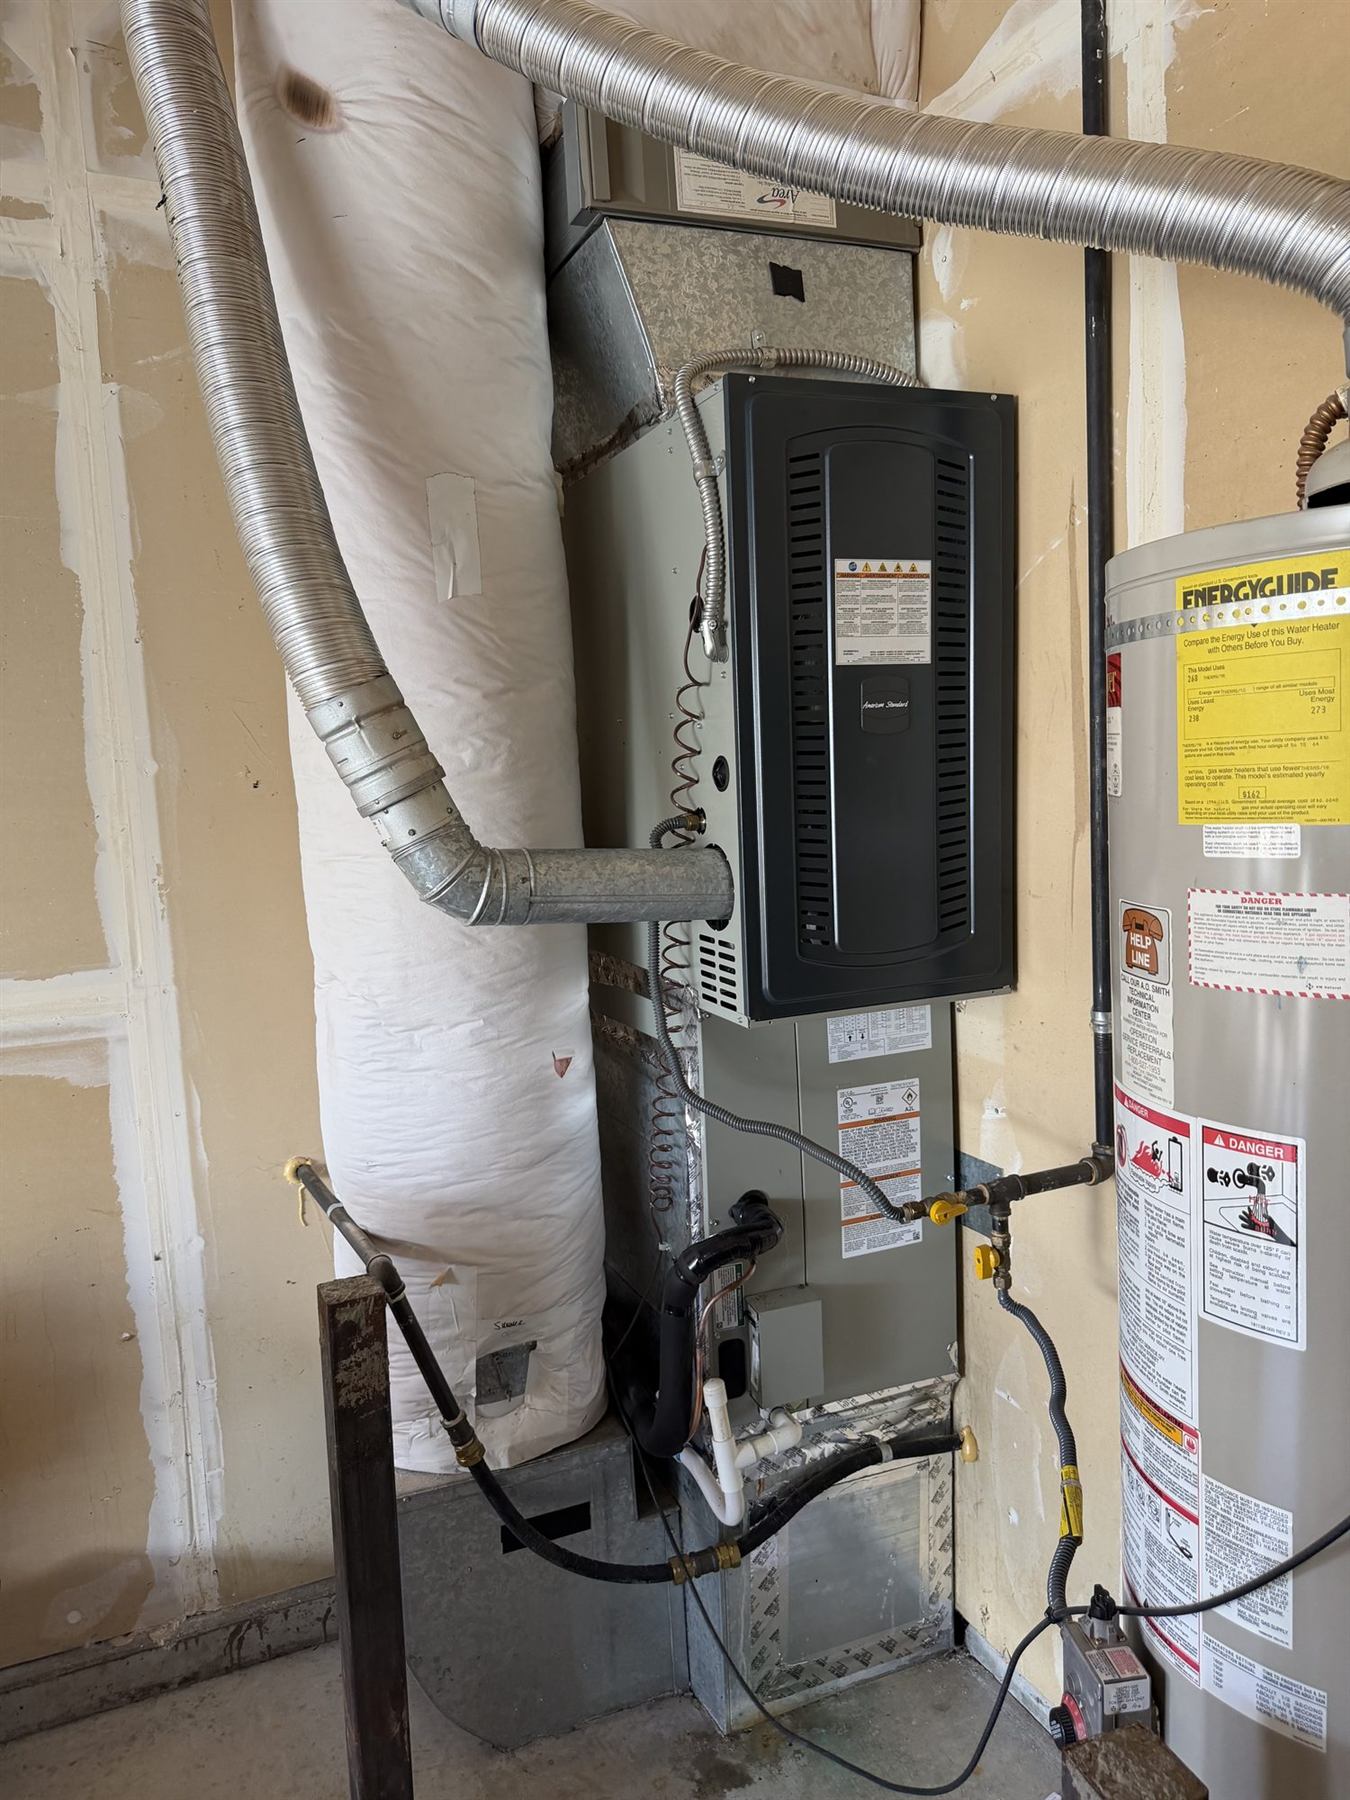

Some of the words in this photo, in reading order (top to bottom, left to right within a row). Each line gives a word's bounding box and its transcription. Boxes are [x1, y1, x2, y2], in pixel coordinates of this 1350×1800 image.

[772, 187, 800, 204] Area
[1183, 568, 1338, 610] ENERGYGUIDE
[1184, 635, 1209, 648] Compare
[1210, 635, 1220, 643] the
[1222, 630, 1245, 644] Energy
[1246, 631, 1260, 639] Use
[1262, 628, 1270, 636] of
[1272, 626, 1285, 636] this
[1286, 623, 1310, 635] Water
[1312, 622, 1340, 632] Heater
[1207, 644, 1220, 654] with
[1221, 644, 1243, 654] Others
[1244, 640, 1268, 649] Before
[1270, 639, 1285, 647] You
[1287, 637, 1304, 646] Buy.
[862, 701, 884, 710] American
[1189, 714, 1200, 722] 238
[1242, 790, 1261, 799] $162
[1240, 897, 1282, 905] DANGER
[1130, 933, 1152, 948] HELP
[1131, 951, 1150, 968] LINE
[1129, 987, 1155, 1003] TECHNICAL
[1131, 978, 1140, 986] OUR
[1152, 985, 1170, 996] SMITH
[1127, 996, 1159, 1013] INFORMATION
[1132, 1008, 1151, 1021] CENTER
[1129, 1027, 1157, 1045] OPERATION
[1123, 1032, 1138, 1048] SERVICE
[1140, 1041, 1171, 1060] REFERRALS
[1127, 1044, 1161, 1065] REPLACEMENT
[1128, 1097, 1149, 1118] DANGER
[1229, 1138, 1284, 1159] DANGER
[1295, 1700, 1323, 1716] SECOND
